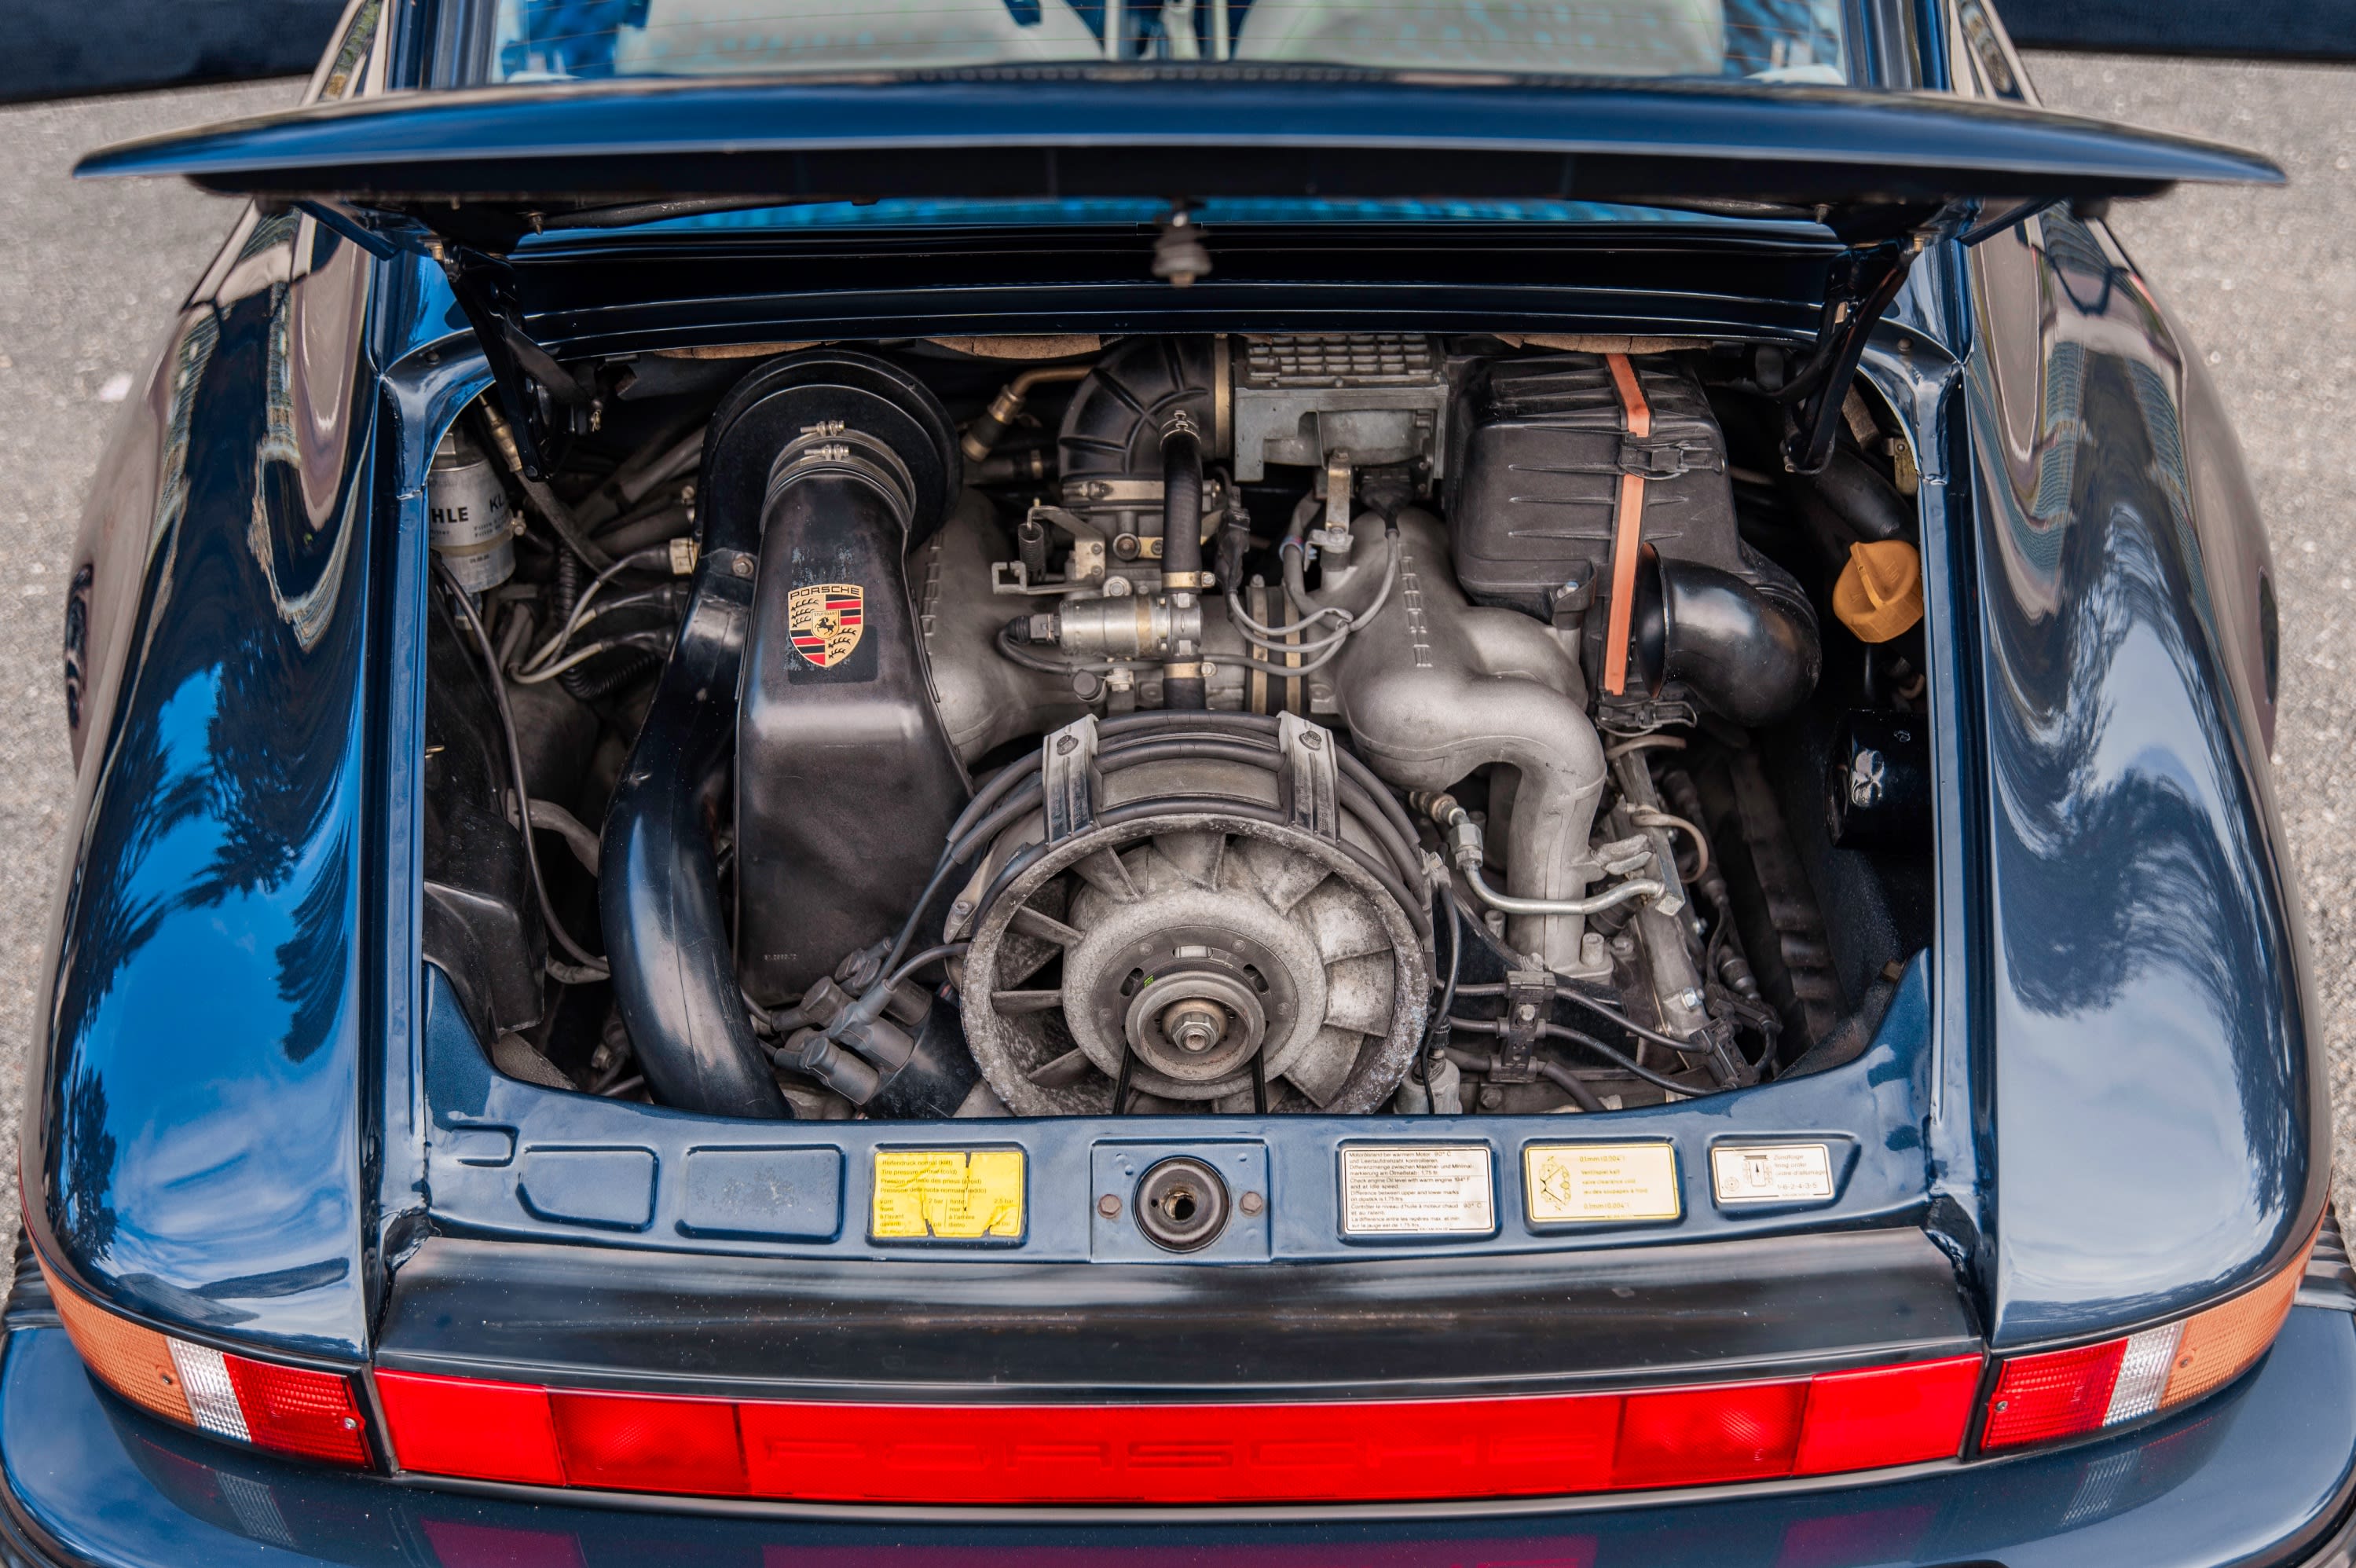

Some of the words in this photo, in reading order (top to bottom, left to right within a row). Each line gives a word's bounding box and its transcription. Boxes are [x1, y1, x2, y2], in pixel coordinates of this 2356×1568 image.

[431, 507, 469, 523] HLE
[790, 586, 859, 600] PORSCHE
[765, 1434, 1599, 1471] PORSCHE
